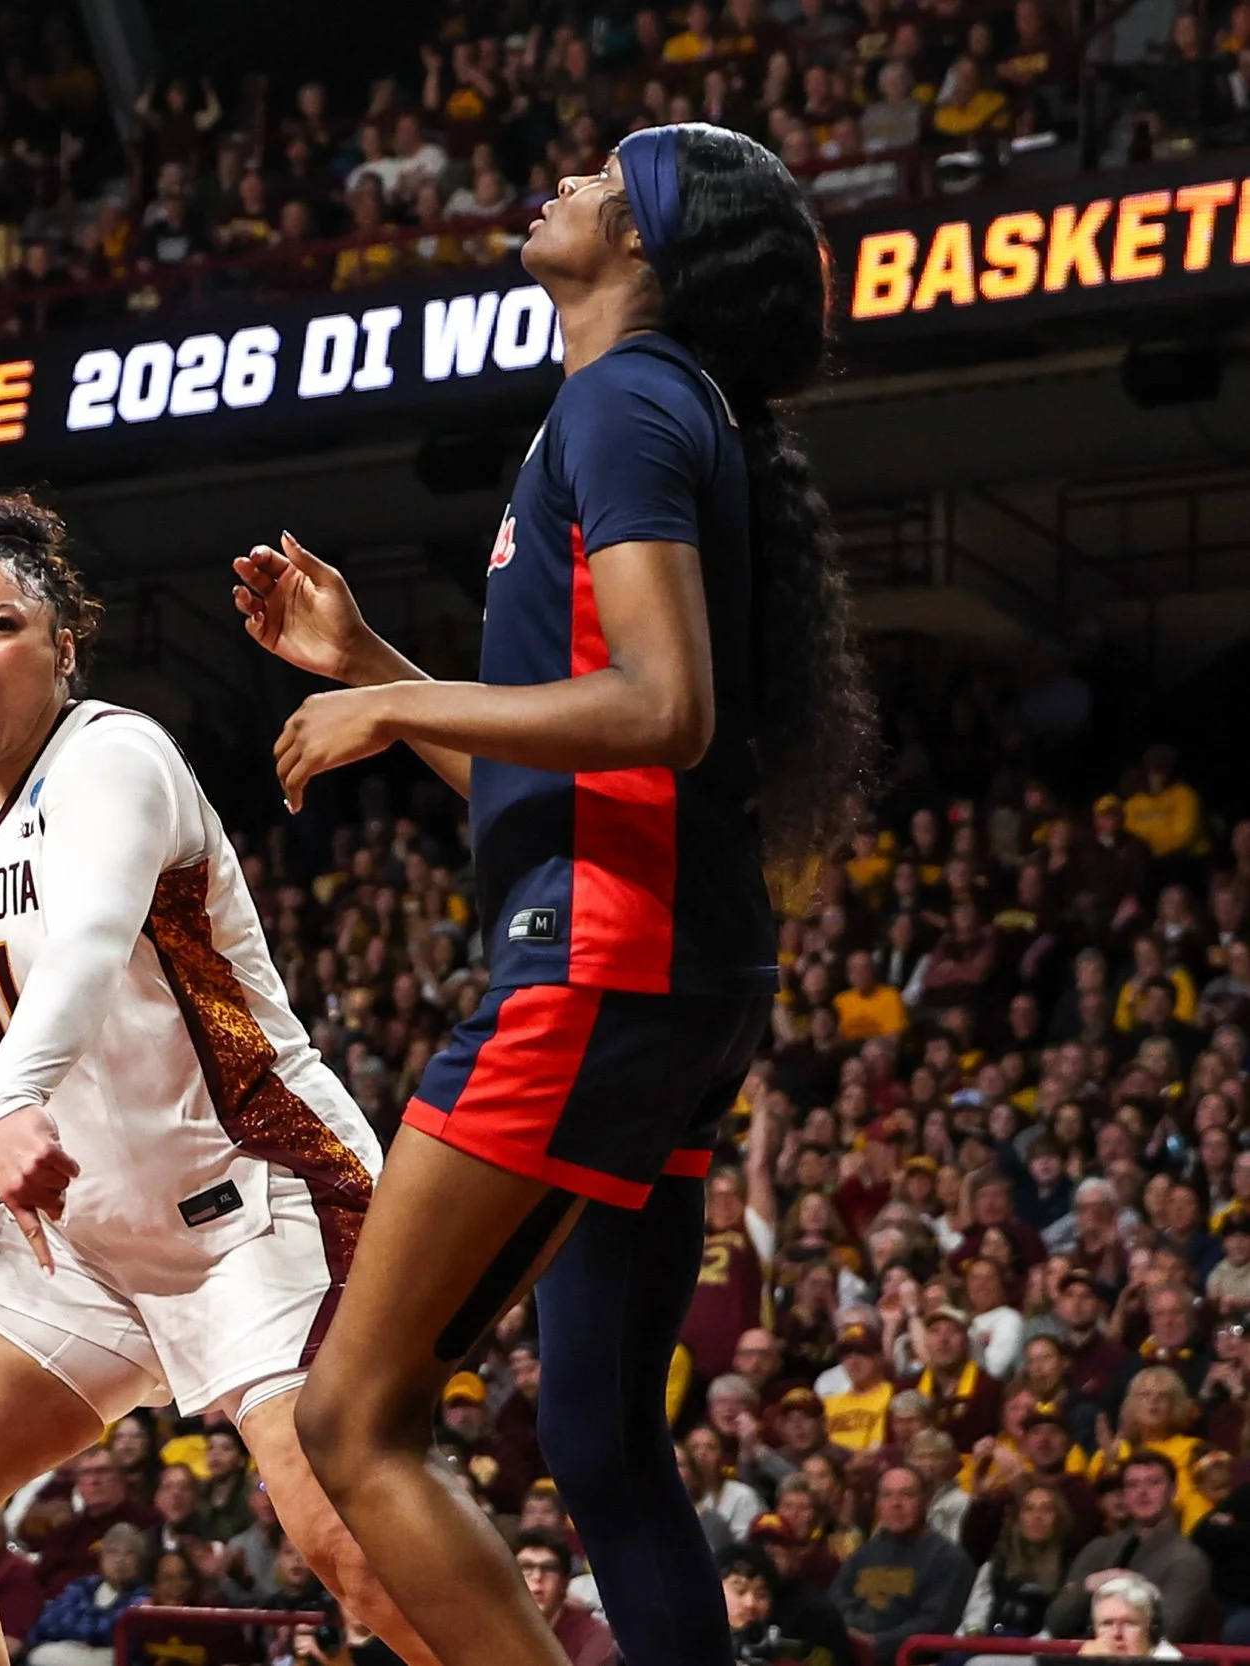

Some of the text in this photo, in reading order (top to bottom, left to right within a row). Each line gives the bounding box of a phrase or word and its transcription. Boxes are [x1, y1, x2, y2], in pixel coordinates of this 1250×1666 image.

[67, 284, 566, 431] 2026 DI WO
[535, 916, 547, 930] M
